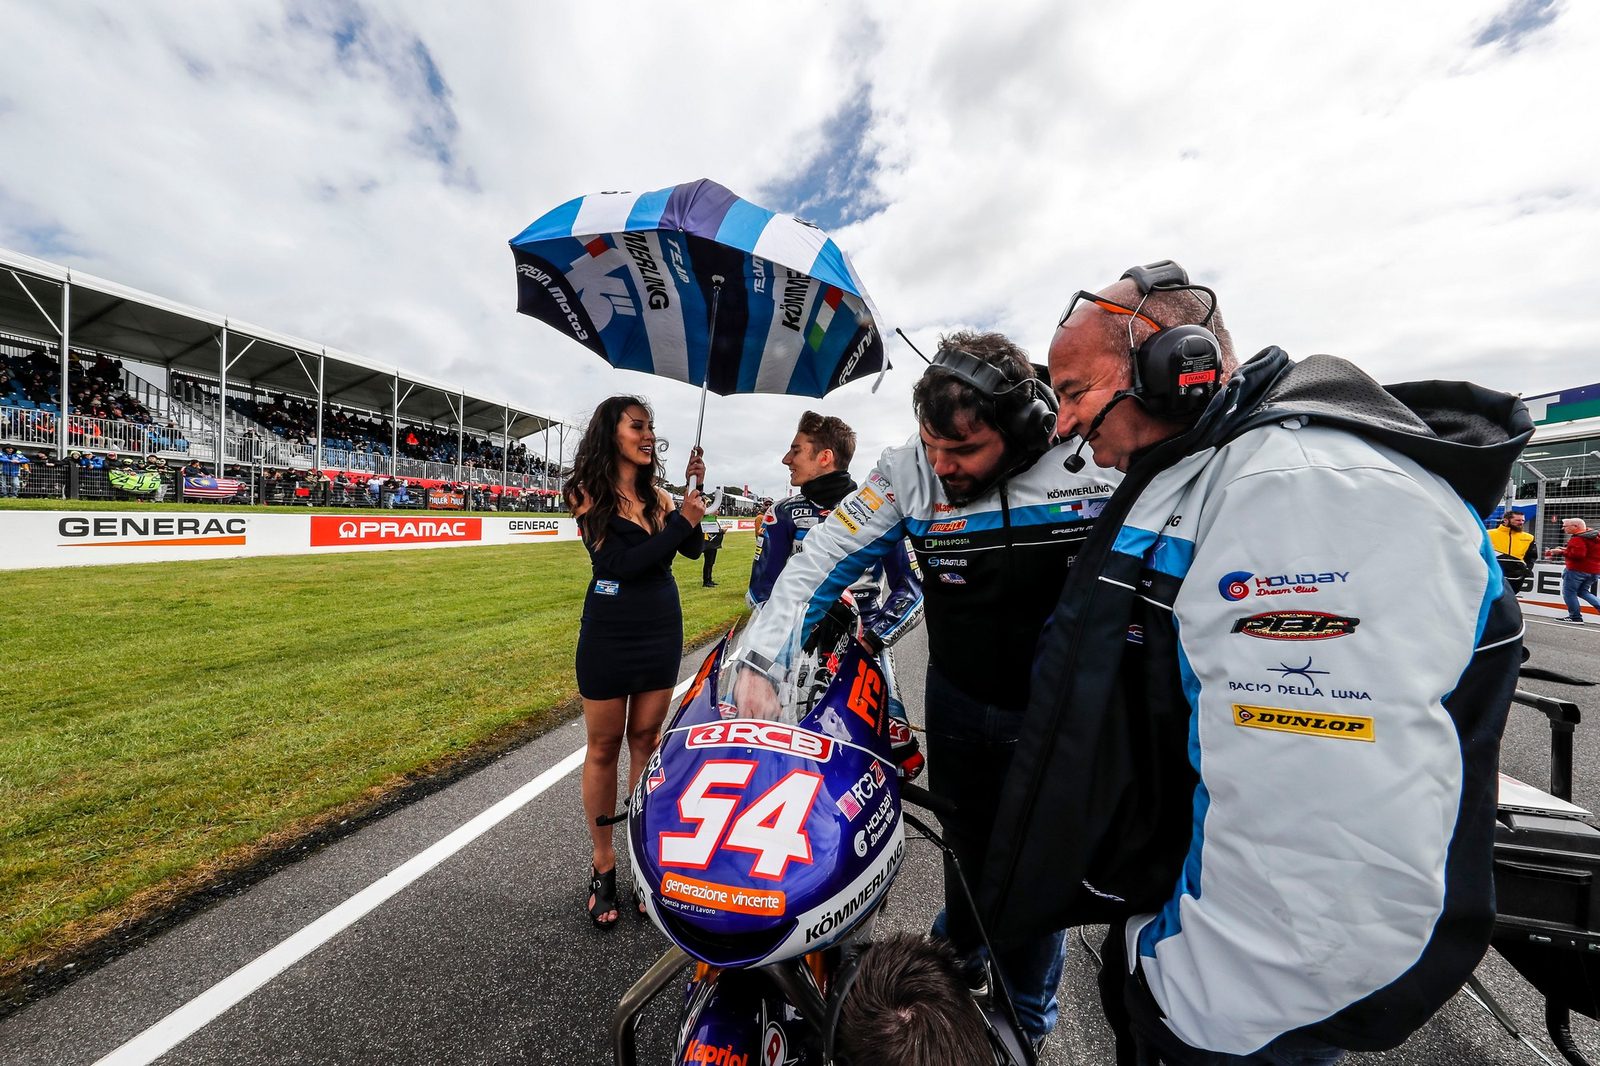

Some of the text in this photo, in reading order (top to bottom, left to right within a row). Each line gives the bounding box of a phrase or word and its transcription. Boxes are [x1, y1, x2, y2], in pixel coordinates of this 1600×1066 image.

[781, 266, 812, 333] KÖMME
[1046, 484, 1110, 500] KÖMMERLING
[58, 517, 247, 538] GENERAC
[360, 522, 467, 538] PRAMAC
[508, 520, 560, 531] GENERAC
[1255, 571, 1350, 587] HOLIDAY
[1255, 585, 1318, 597] Dream Club
[1277, 685, 1324, 697] DELLA
[1331, 689, 1373, 701] LUNA
[1257, 712, 1365, 732] DUNLOP
[726, 722, 823, 756] RCB
[659, 759, 824, 882] 54
[865, 787, 893, 834] HOLIDAY
[665, 878, 728, 903] generazione
[731, 891, 779, 909] vincente
[805, 840, 903, 944] KÖMMERLING
[680, 903, 690, 911] per
[695, 906, 716, 915] Lavoro
[683, 1039, 749, 1066] Kapriol
